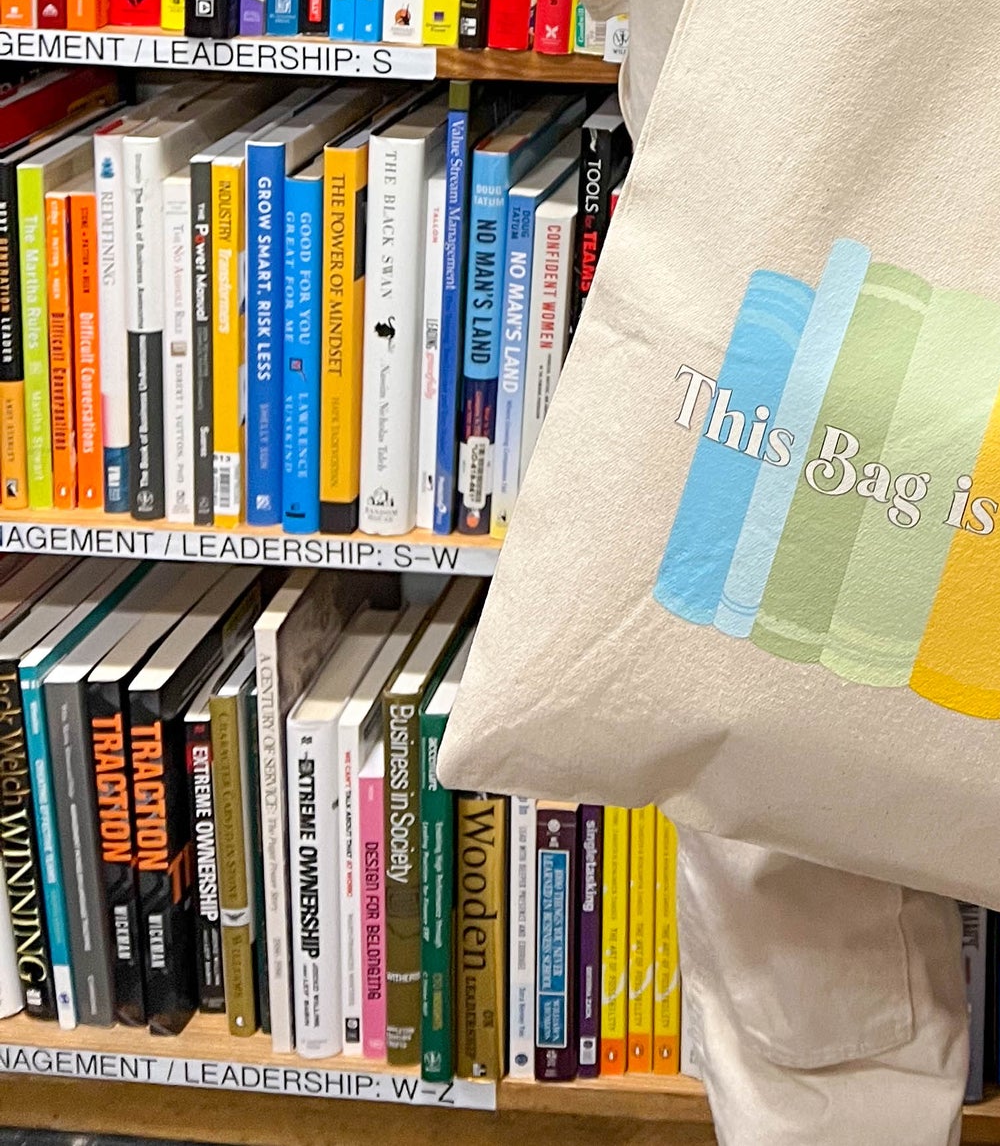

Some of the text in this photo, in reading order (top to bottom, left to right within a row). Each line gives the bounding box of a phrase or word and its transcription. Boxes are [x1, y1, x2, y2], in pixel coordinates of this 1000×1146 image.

[153, 39, 360, 73] LEADERSHIP:
[373, 49, 392, 74] S
[101, 191, 115, 287] REDEFINING
[257, 177, 272, 229] GROW
[381, 151, 397, 298] THE BLACK SWAN
[477, 219, 497, 244] NO
[257, 300, 272, 337] RISK
[327, 174, 345, 378] THE POWER OF MINDSET
[473, 251, 496, 310] MAN'S
[540, 225, 561, 349] CONFIDENT WOMEN
[257, 343, 271, 381] LESS
[470, 317, 493, 364] LAND
[673, 363, 796, 468] This
[803, 424, 930, 529] Bag
[943, 473, 999, 535] is
[0, 525, 153, 556] AGEMENT
[183, 535, 382, 566] LEADERSHIP:
[92, 713, 132, 862] TRACTION
[131, 720, 169, 870] TRACTION
[192, 746, 212, 817] EXTREME
[387, 705, 414, 884] Business in Society
[1, 808, 47, 983] WINNING
[195, 824, 219, 921] OWNERSHIP
[462, 806, 497, 973] Wooden
[185, 1062, 380, 1098] LEADERSHIP:
